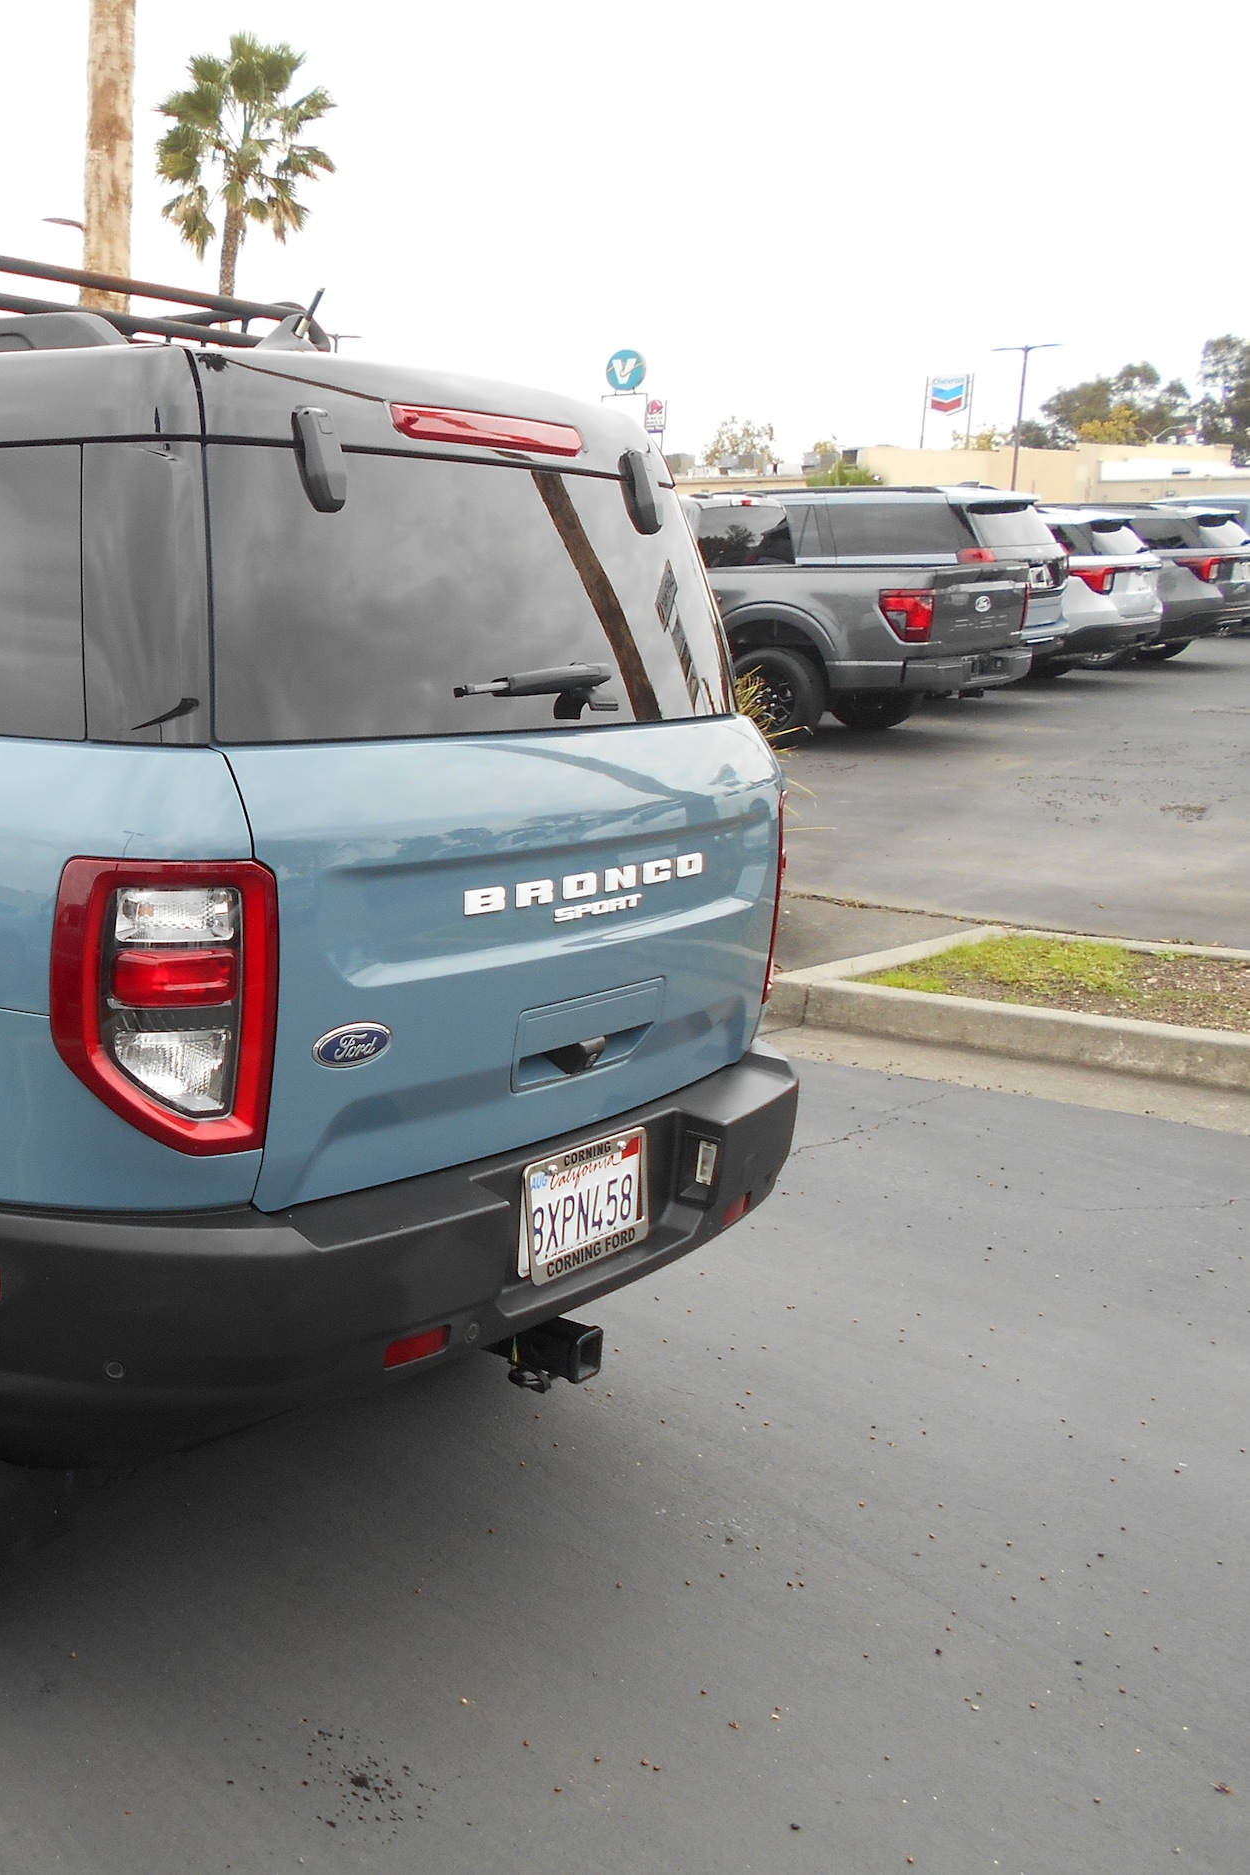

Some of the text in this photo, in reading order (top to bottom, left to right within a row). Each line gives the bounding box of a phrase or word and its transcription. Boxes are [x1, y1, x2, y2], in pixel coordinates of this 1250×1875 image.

[463, 852, 703, 916] BRONCO
[553, 893, 643, 923] SPORT
[334, 1033, 378, 1060] Ford
[563, 1141, 612, 1167] CORNING
[531, 1174, 548, 1191] AUG
[549, 1154, 622, 1191] California
[532, 1173, 633, 1256] 8XPN458
[546, 1241, 601, 1278] CORNING
[605, 1227, 636, 1252] FORD
